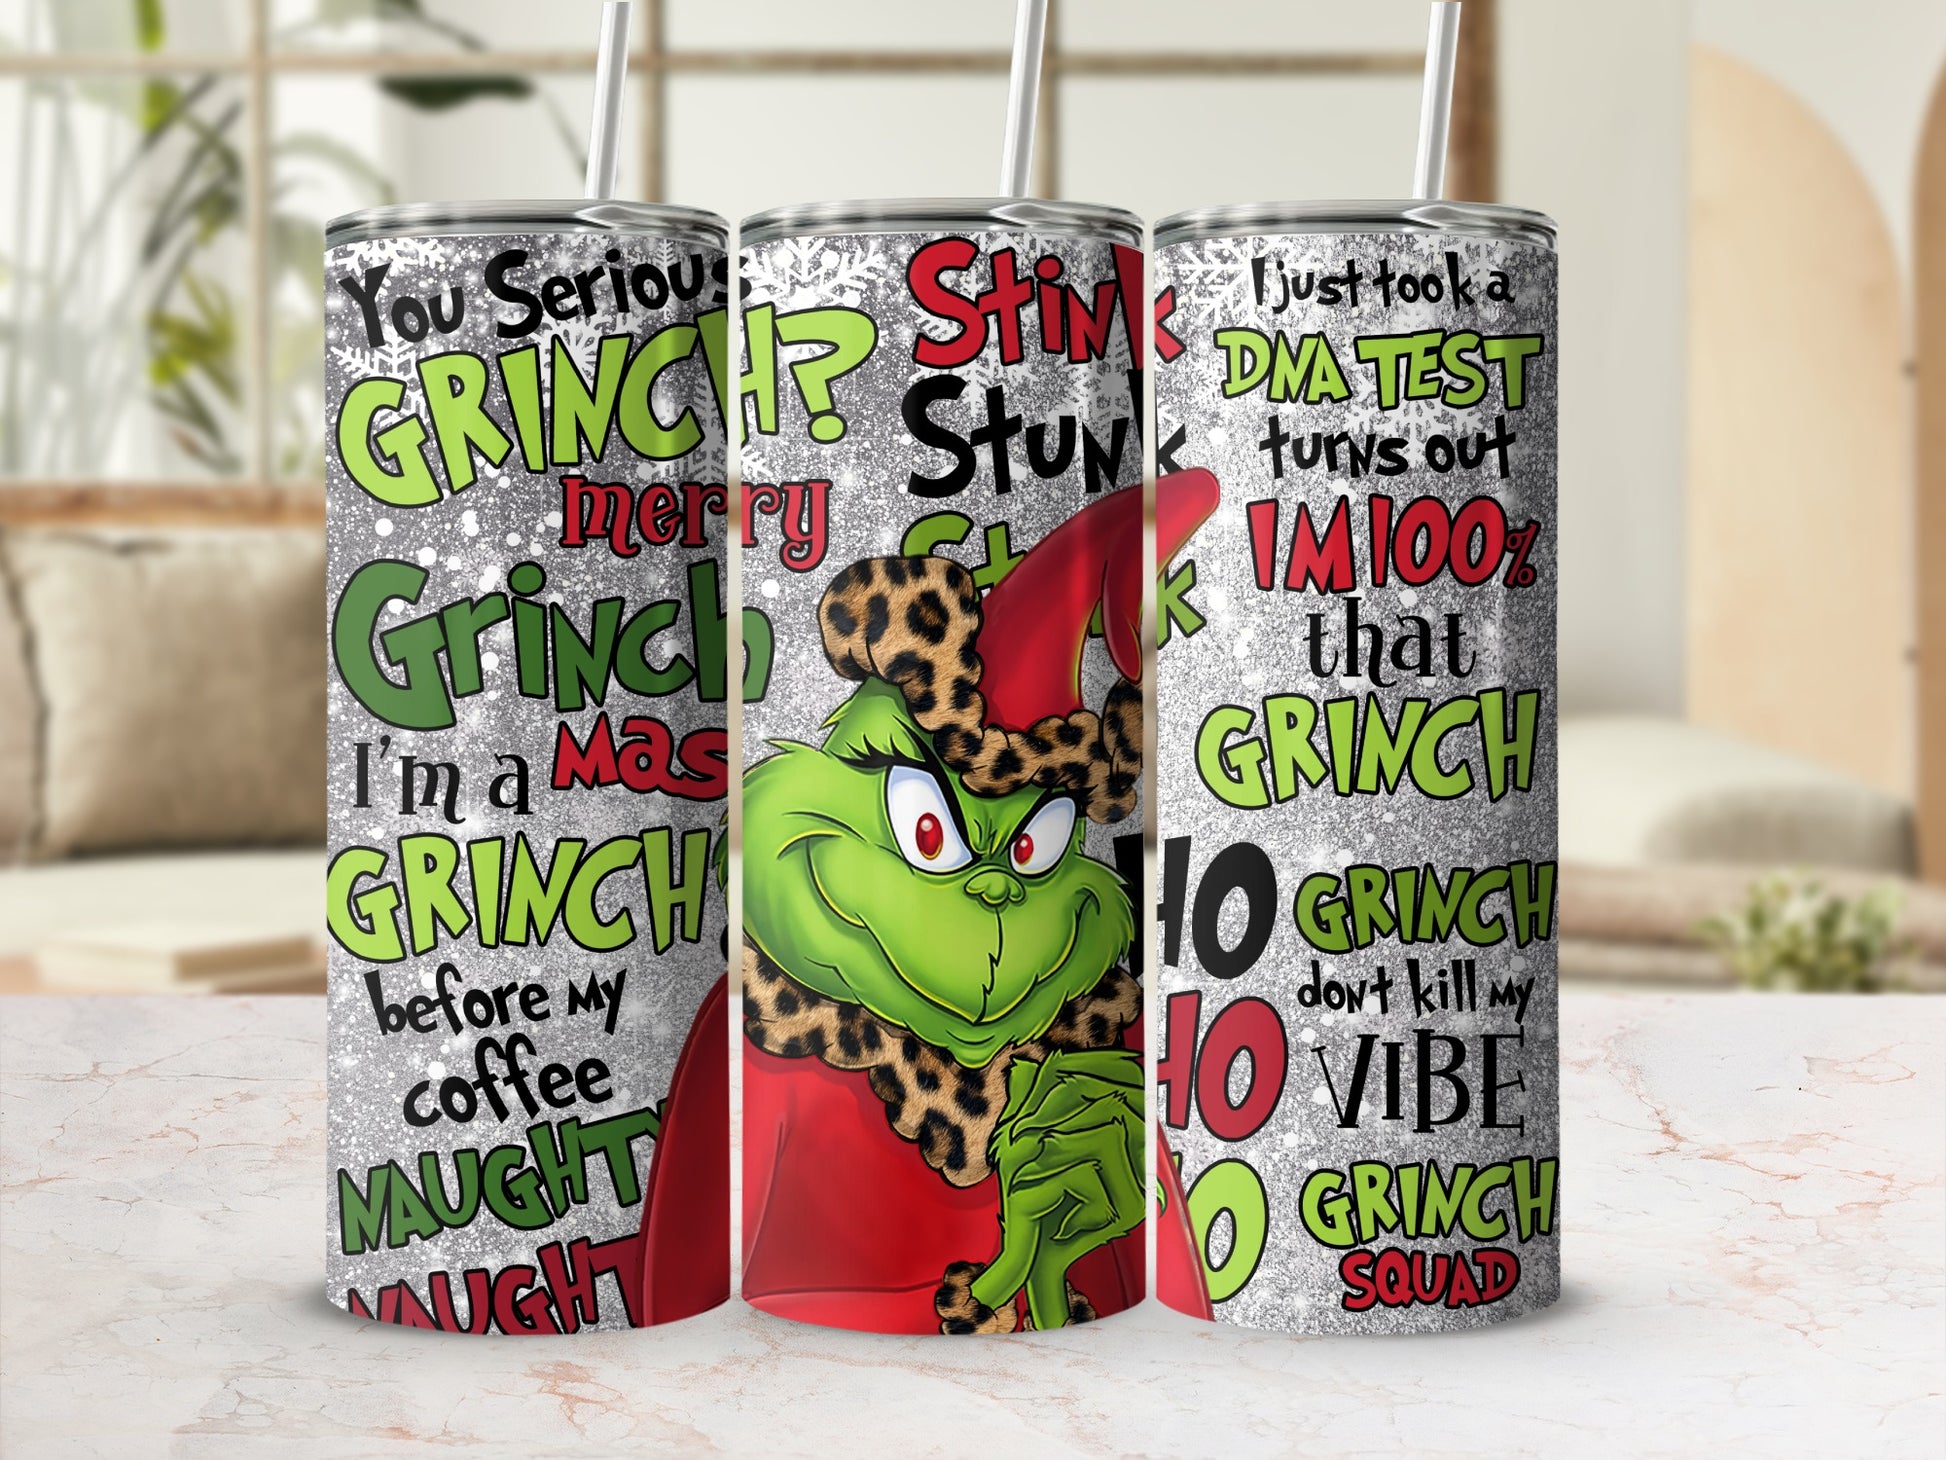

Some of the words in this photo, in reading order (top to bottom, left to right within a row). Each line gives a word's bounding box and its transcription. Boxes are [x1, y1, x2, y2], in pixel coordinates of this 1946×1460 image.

[338, 263, 464, 348] You
[484, 248, 752, 339] Serious
[1251, 256, 1266, 306] I
[1271, 258, 1362, 312] just
[1372, 251, 1472, 312] took
[1486, 270, 1516, 303] a
[1213, 327, 1350, 402] DNA
[1354, 328, 1544, 410] TEST
[1259, 416, 1409, 479] turns
[1425, 415, 1516, 479] out
[559, 475, 833, 573] merry
[1368, 495, 1541, 590] 100%
[332, 558, 775, 731] Grinch
[1303, 597, 1477, 688] that
[353, 734, 465, 824] I'm
[488, 752, 533, 815] a
[1195, 688, 1541, 808] GRINCH
[326, 826, 711, 963] GRINCH
[1293, 860, 1557, 953] GRINCH
[364, 962, 549, 1036] before
[1406, 958, 1476, 1018] kill
[403, 1033, 613, 1127] coffee
[1311, 1025, 1525, 1138] VIBE
[1171, 1151, 1270, 1303] O
[1300, 1156, 1559, 1246] GRINCH
[1339, 1247, 1521, 1312] SQUAD
